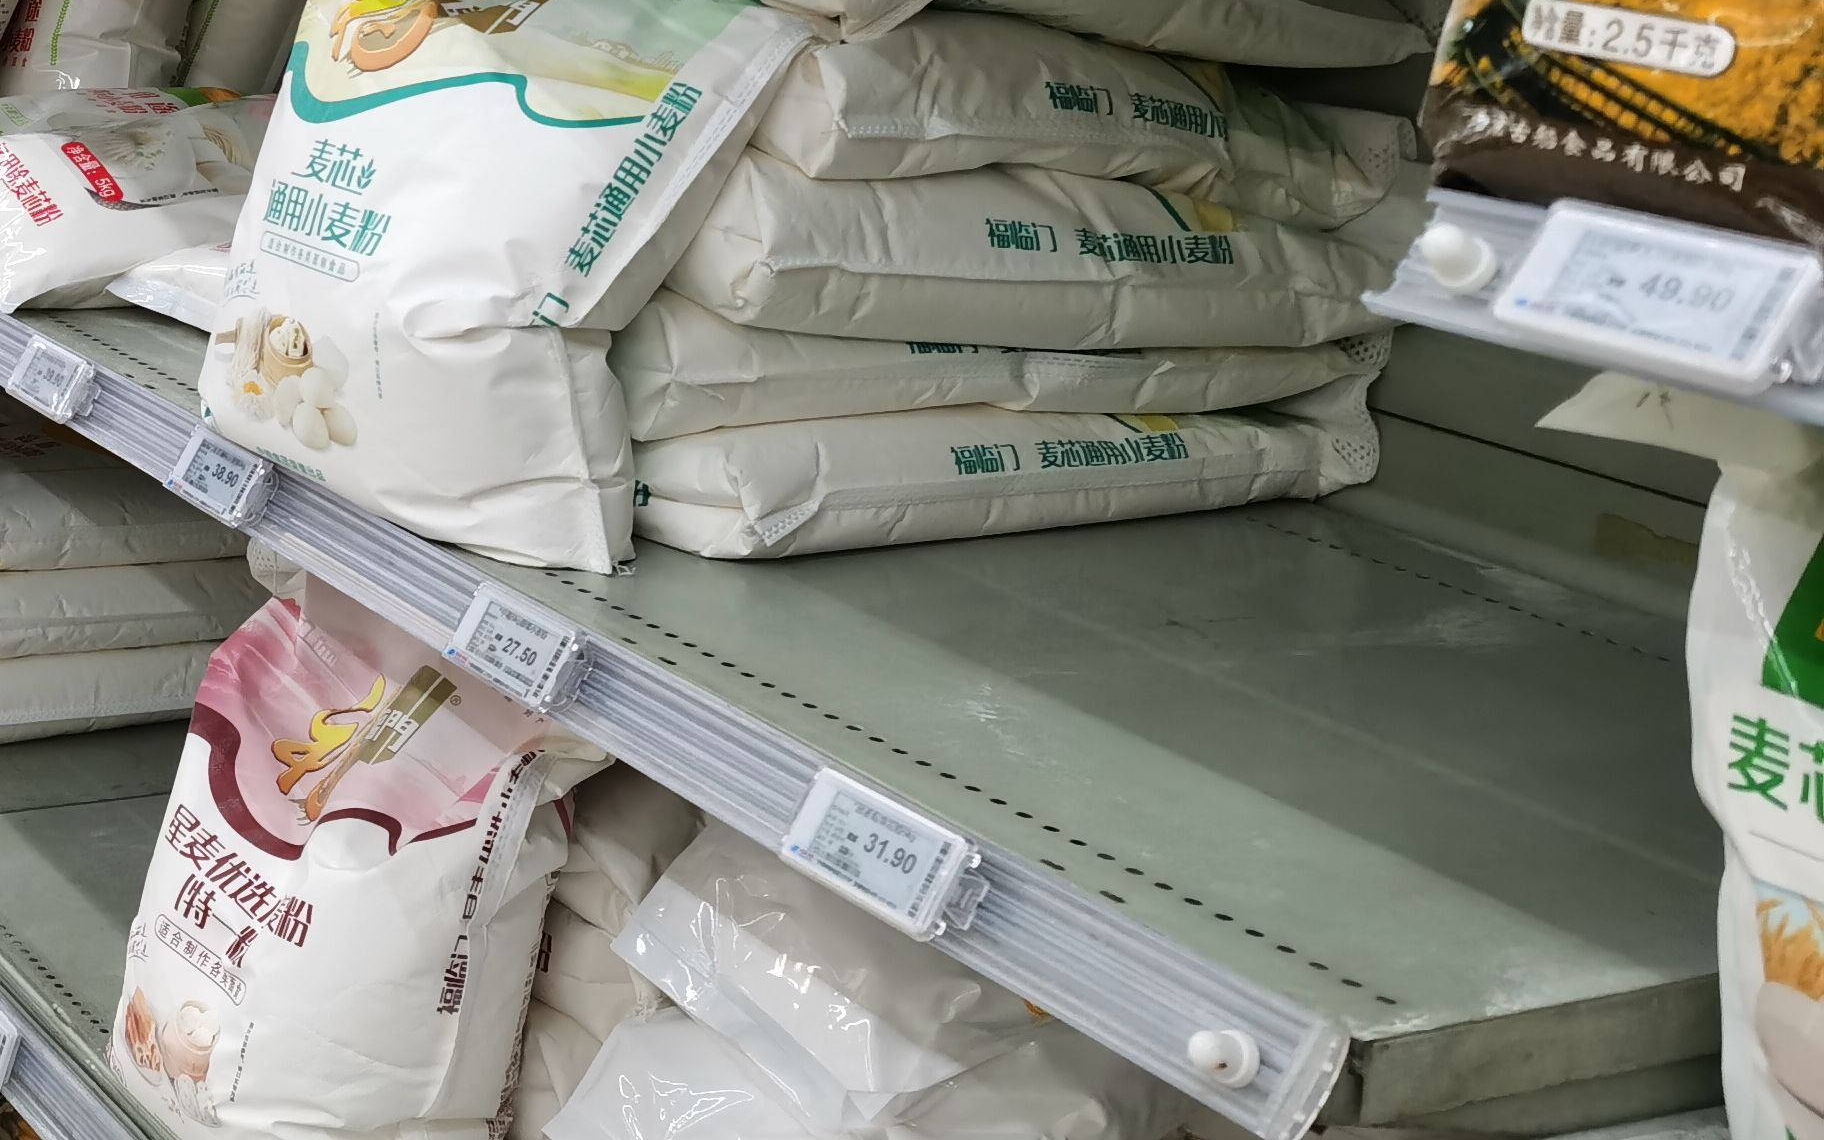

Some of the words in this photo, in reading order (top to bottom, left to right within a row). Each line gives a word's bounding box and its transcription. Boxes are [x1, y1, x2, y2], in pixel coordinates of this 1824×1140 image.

[1044, 81, 1114, 116] 福临门
[94, 176, 116, 199] 5kg
[291, 138, 364, 196] 麦芯
[564, 81, 703, 278] 麦芯通用小麦粉
[262, 178, 393, 257] 通用小麦粉
[984, 218, 1058, 253] 福临门
[1073, 227, 1236, 265] 麦芯通用小麦粉
[950, 443, 1021, 475] 福临门
[1034, 431, 1190, 469] 麦芯通用小麦粉
[211, 463, 240, 488] 38.90
[502, 637, 538, 666] 27.50
[862, 832, 917, 876] 31.90
